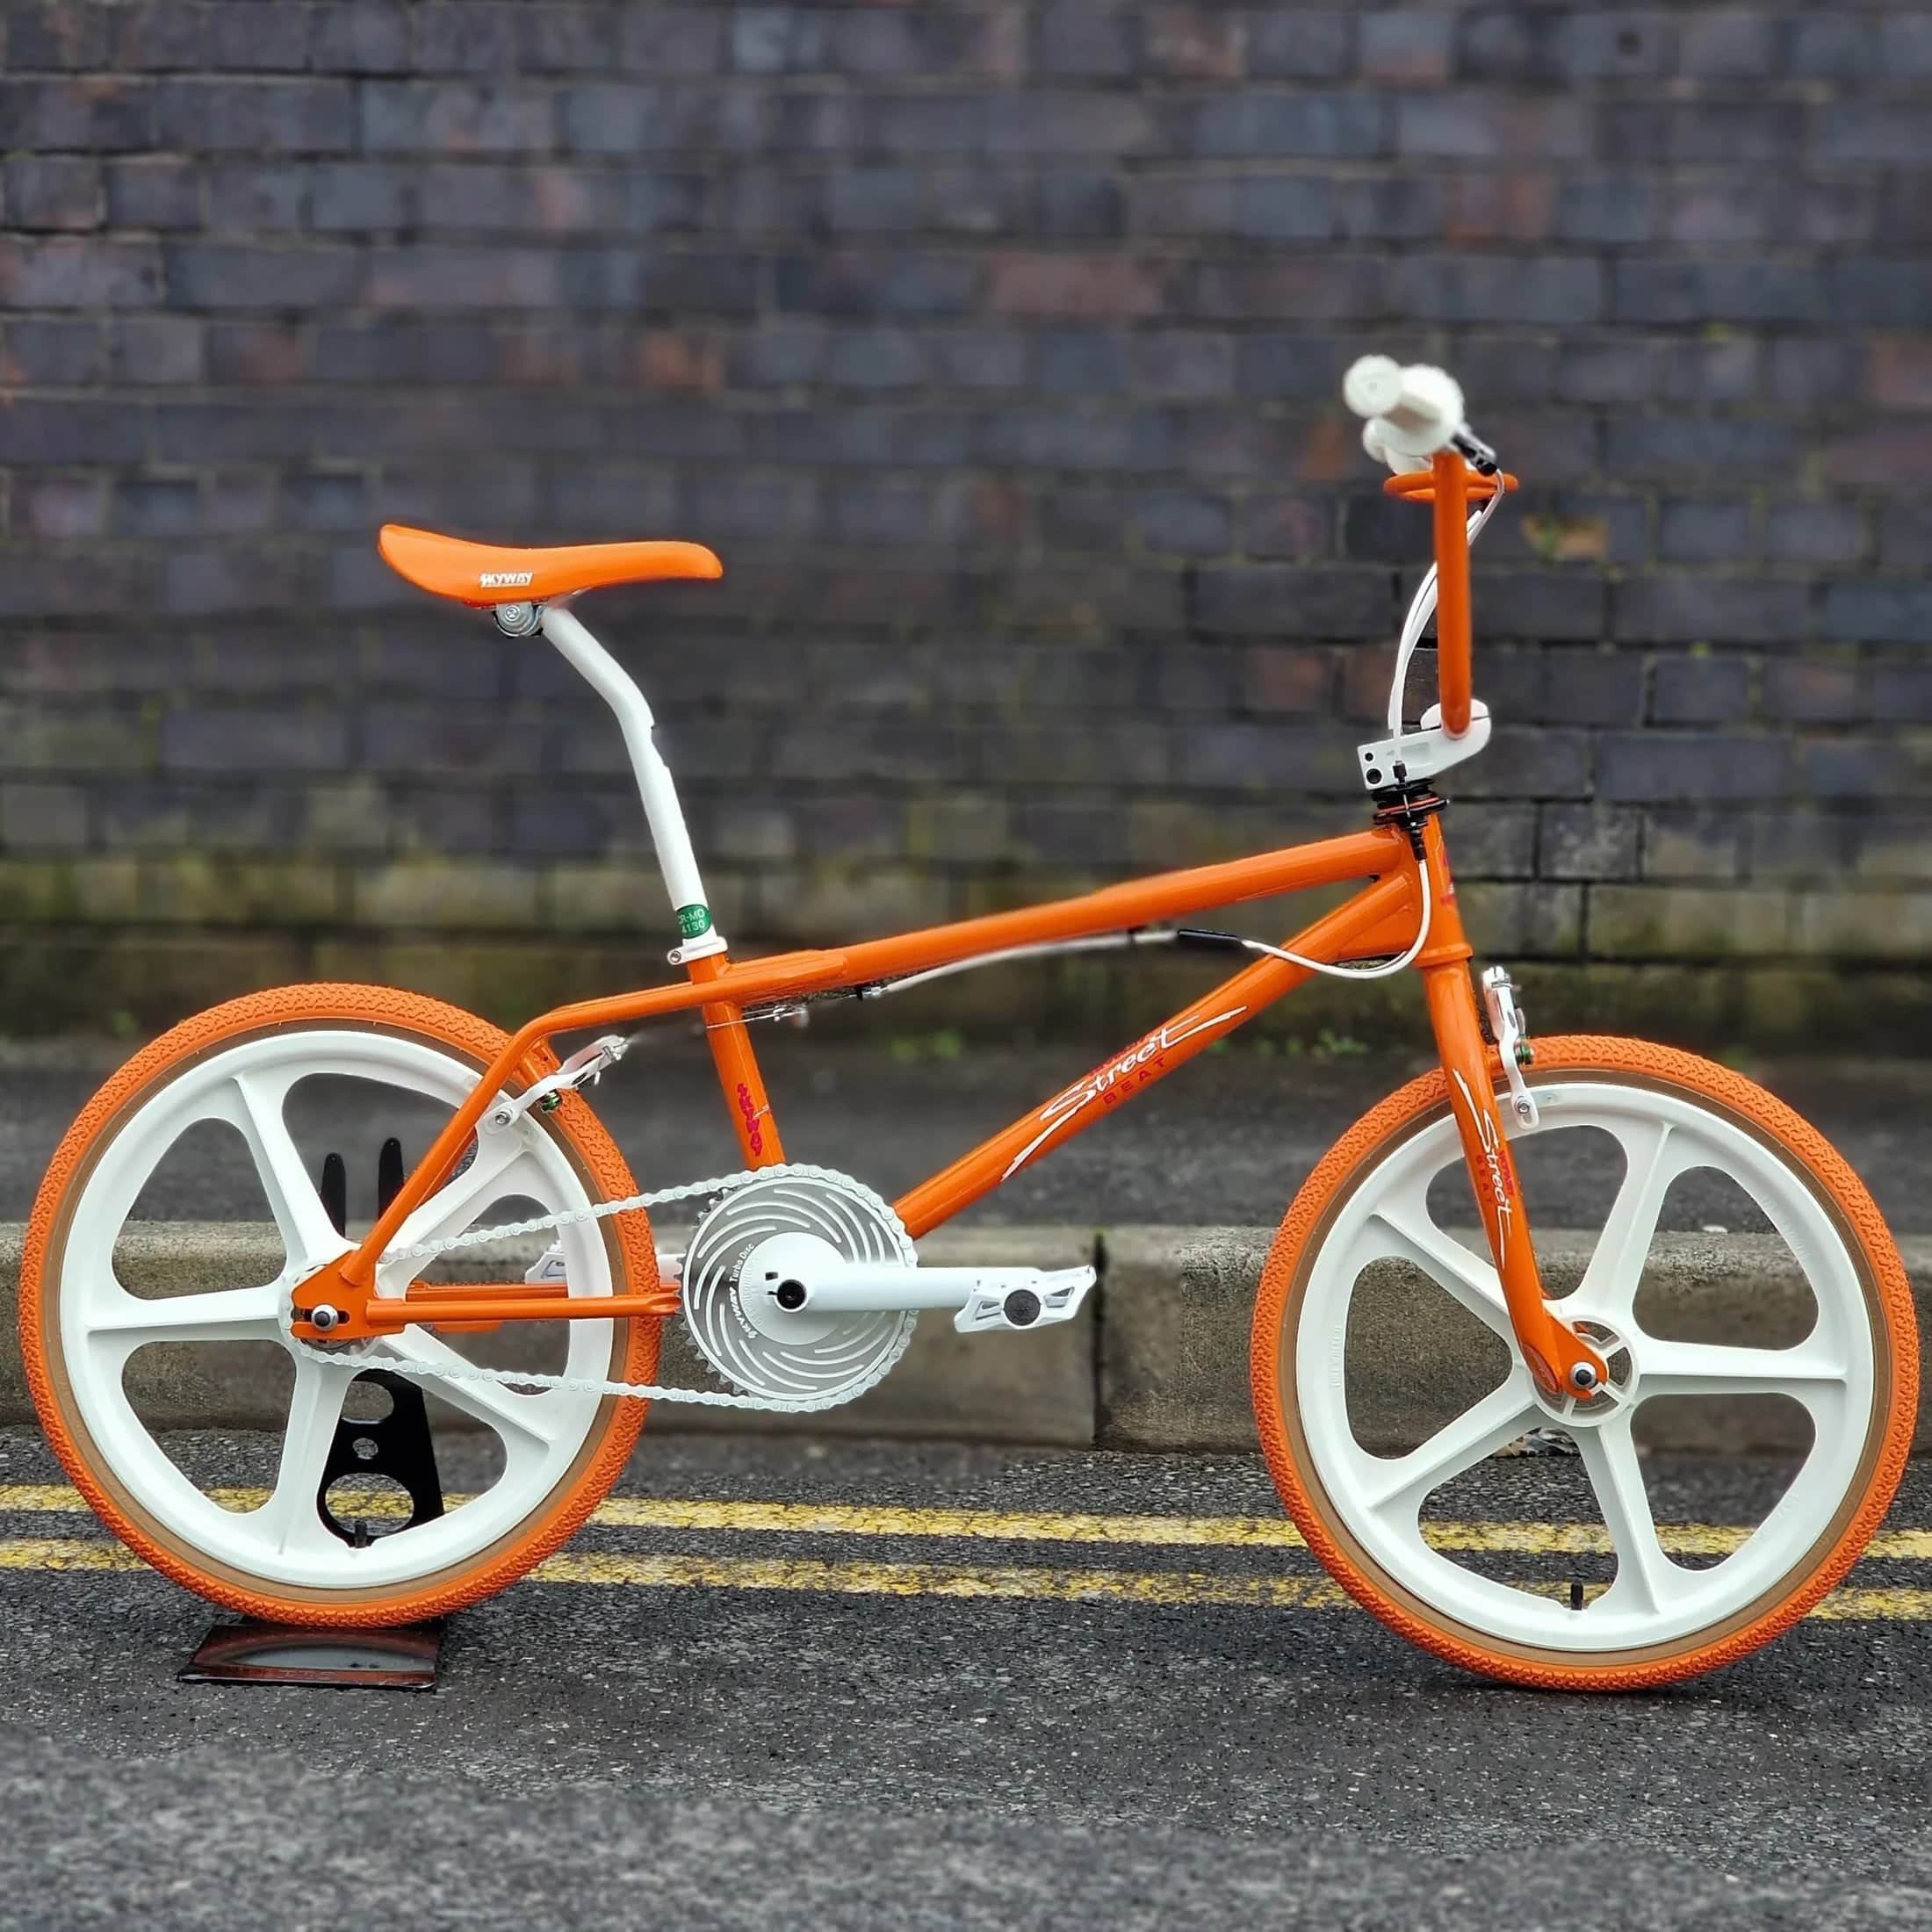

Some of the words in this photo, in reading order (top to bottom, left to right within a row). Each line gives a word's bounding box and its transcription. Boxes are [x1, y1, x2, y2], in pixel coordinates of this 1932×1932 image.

[479, 572, 533, 588] SKYWAY
[681, 919, 705, 934] 4130
[1102, 1056, 1166, 1106] BEAT
[1000, 1005, 1247, 1182] Street
[728, 1258, 743, 1282] Turbo
